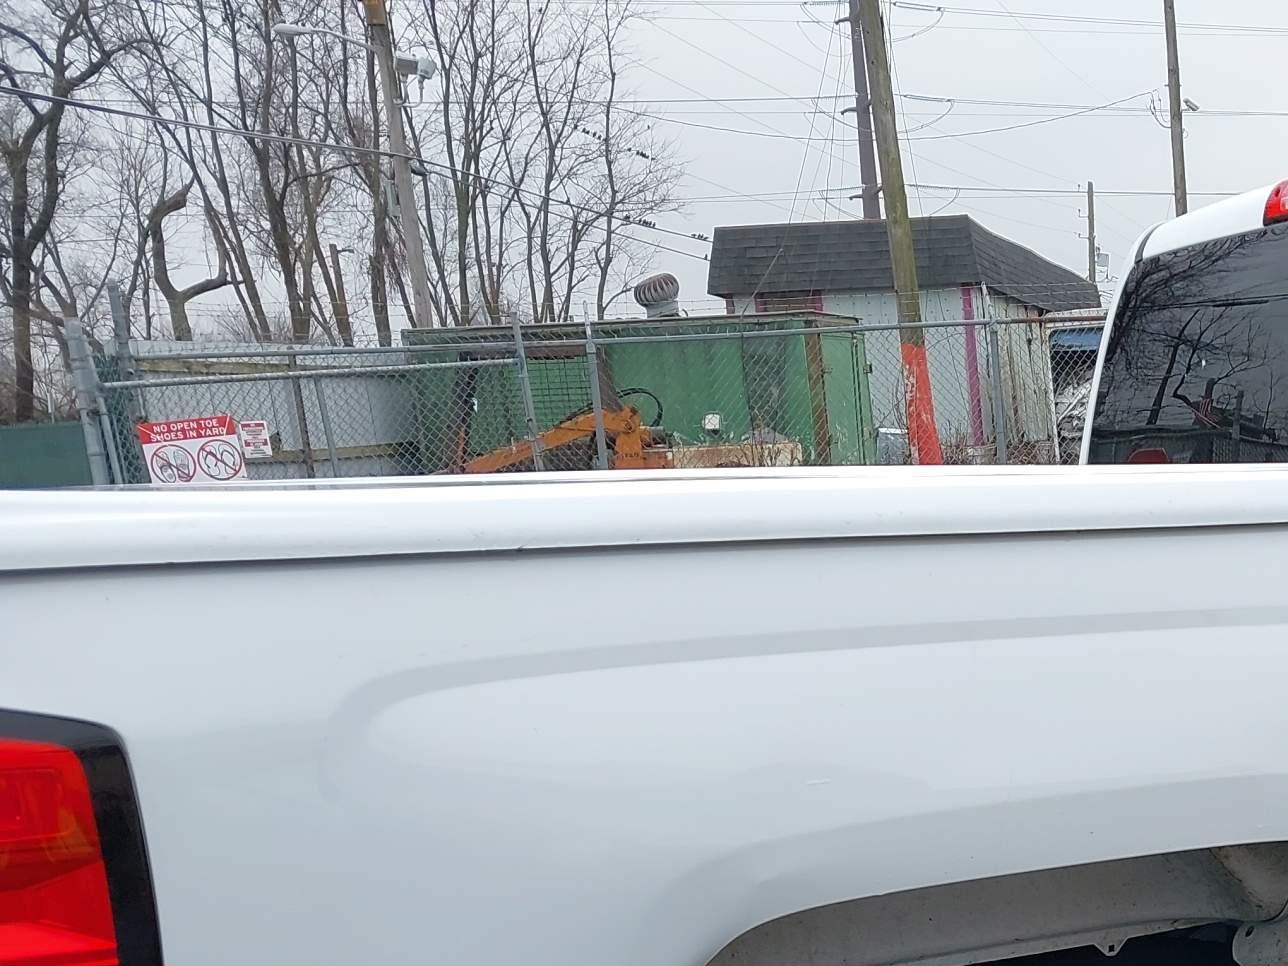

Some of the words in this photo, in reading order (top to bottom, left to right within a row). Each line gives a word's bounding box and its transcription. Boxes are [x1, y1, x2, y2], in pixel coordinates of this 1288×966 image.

[153, 424, 168, 433] NO
[170, 421, 197, 431] OPEN
[200, 418, 219, 428] TOE
[150, 432, 184, 443] SHOES
[186, 429, 196, 439] IN
[199, 426, 226, 437] YARD
